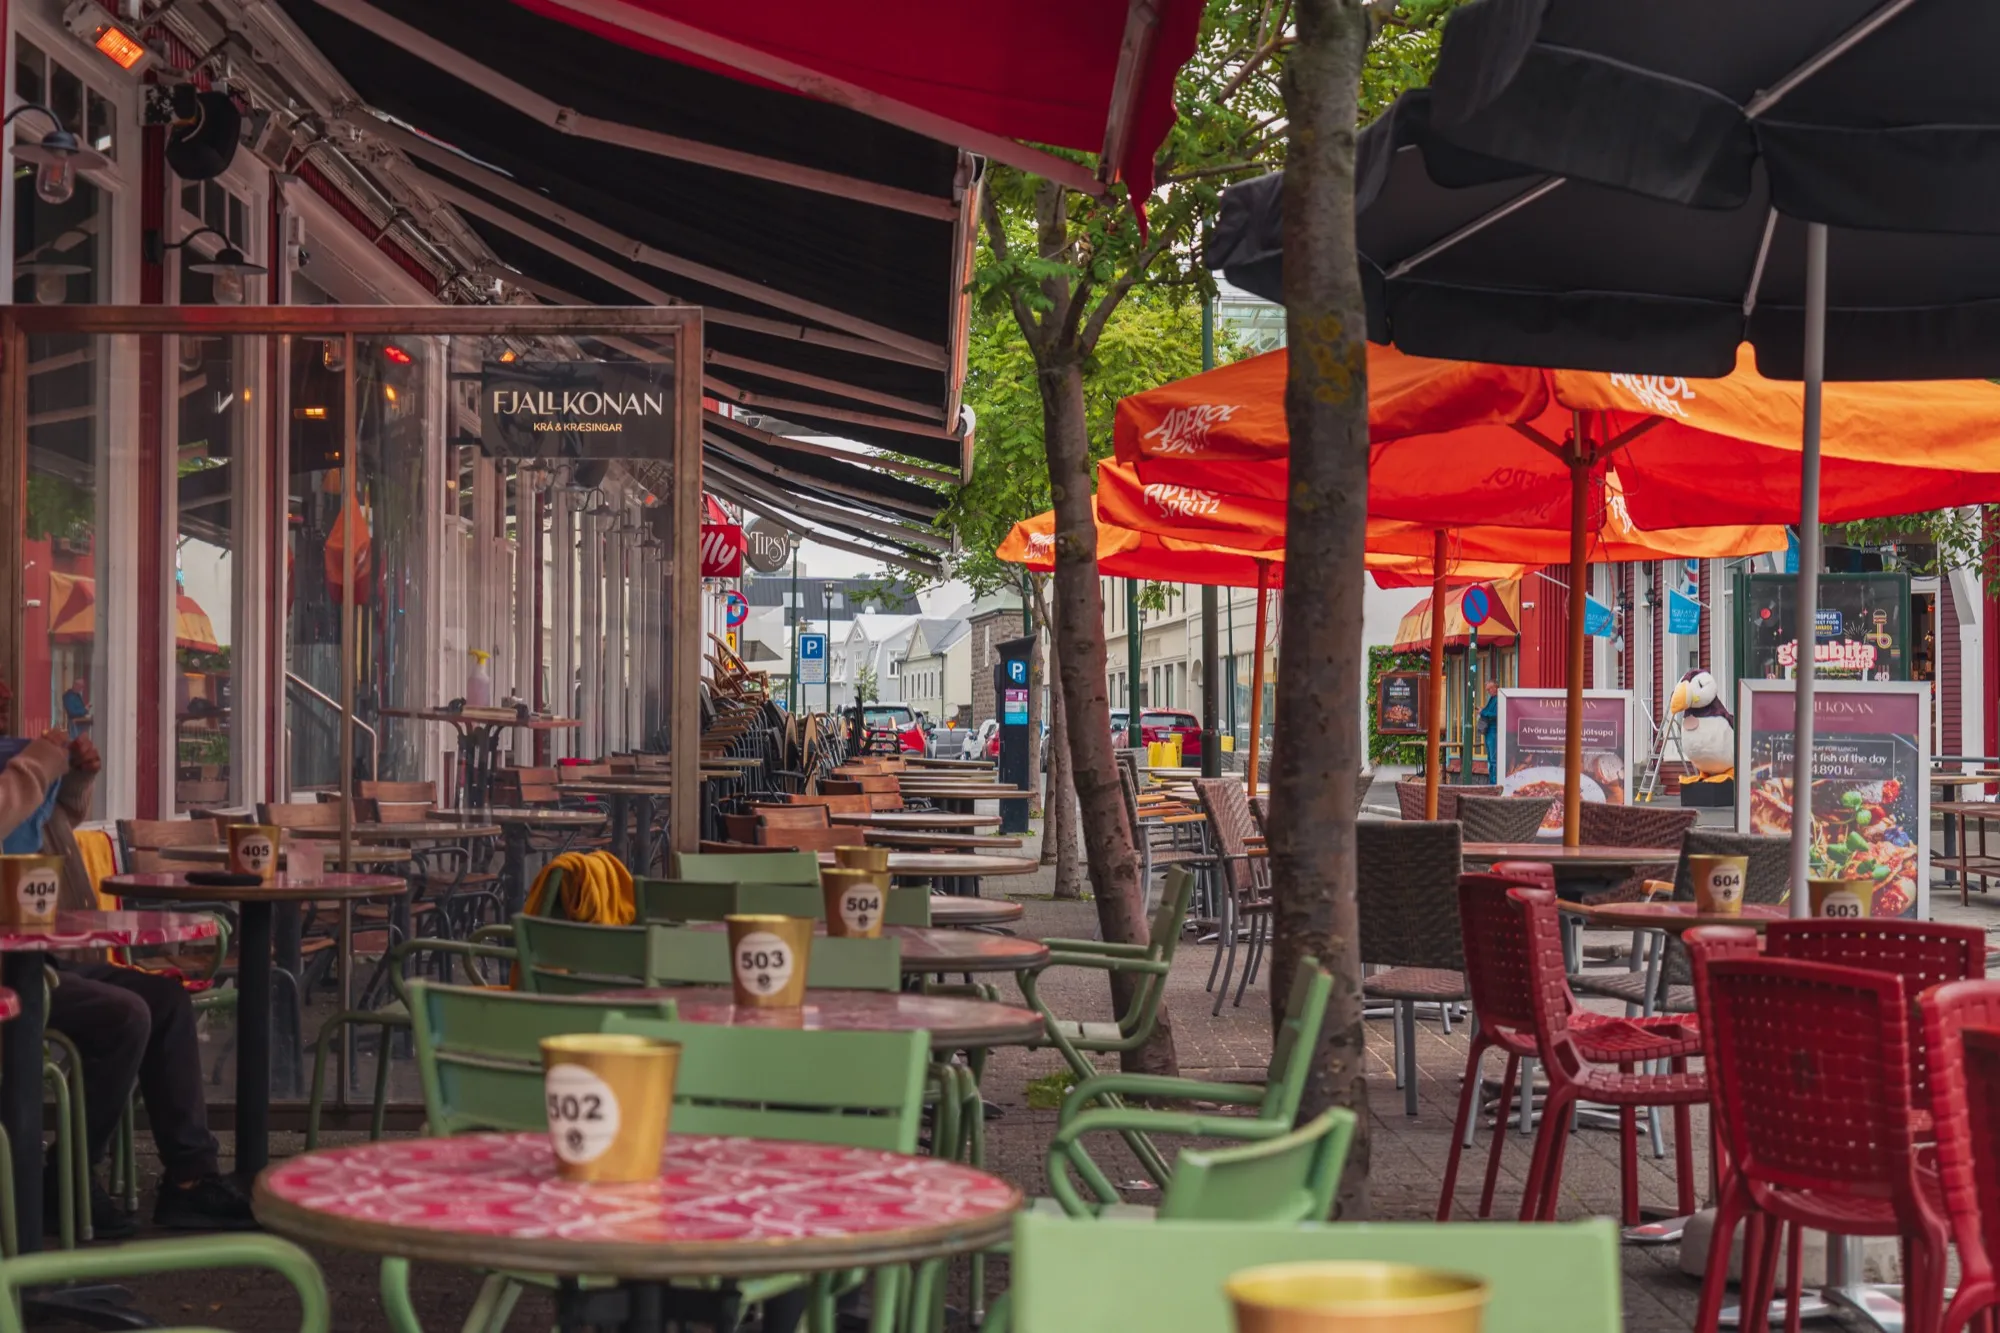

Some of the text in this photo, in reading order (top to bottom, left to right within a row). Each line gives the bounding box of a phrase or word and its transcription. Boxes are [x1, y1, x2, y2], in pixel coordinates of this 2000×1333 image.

[493, 391, 663, 416] FJALLKONAN
[533, 421, 623, 432] KRÁ & KRÆSINGAR
[1144, 483, 1230, 505] APER
[1159, 498, 1221, 519] SPRITZ
[702, 531, 737, 573] lly
[750, 531, 789, 563] TIPSY
[1580, 728, 1614, 738] jötsúpa
[1820, 752, 1837, 763] fish
[1838, 752, 1849, 763] of
[1851, 753, 1868, 764] the
[1869, 753, 1888, 766] day
[242, 844, 270, 857] 405
[1713, 874, 1740, 887] 604
[23, 881, 56, 896] 404
[846, 897, 879, 912] 504
[1826, 904, 1859, 918] 603
[741, 950, 785, 969] 503
